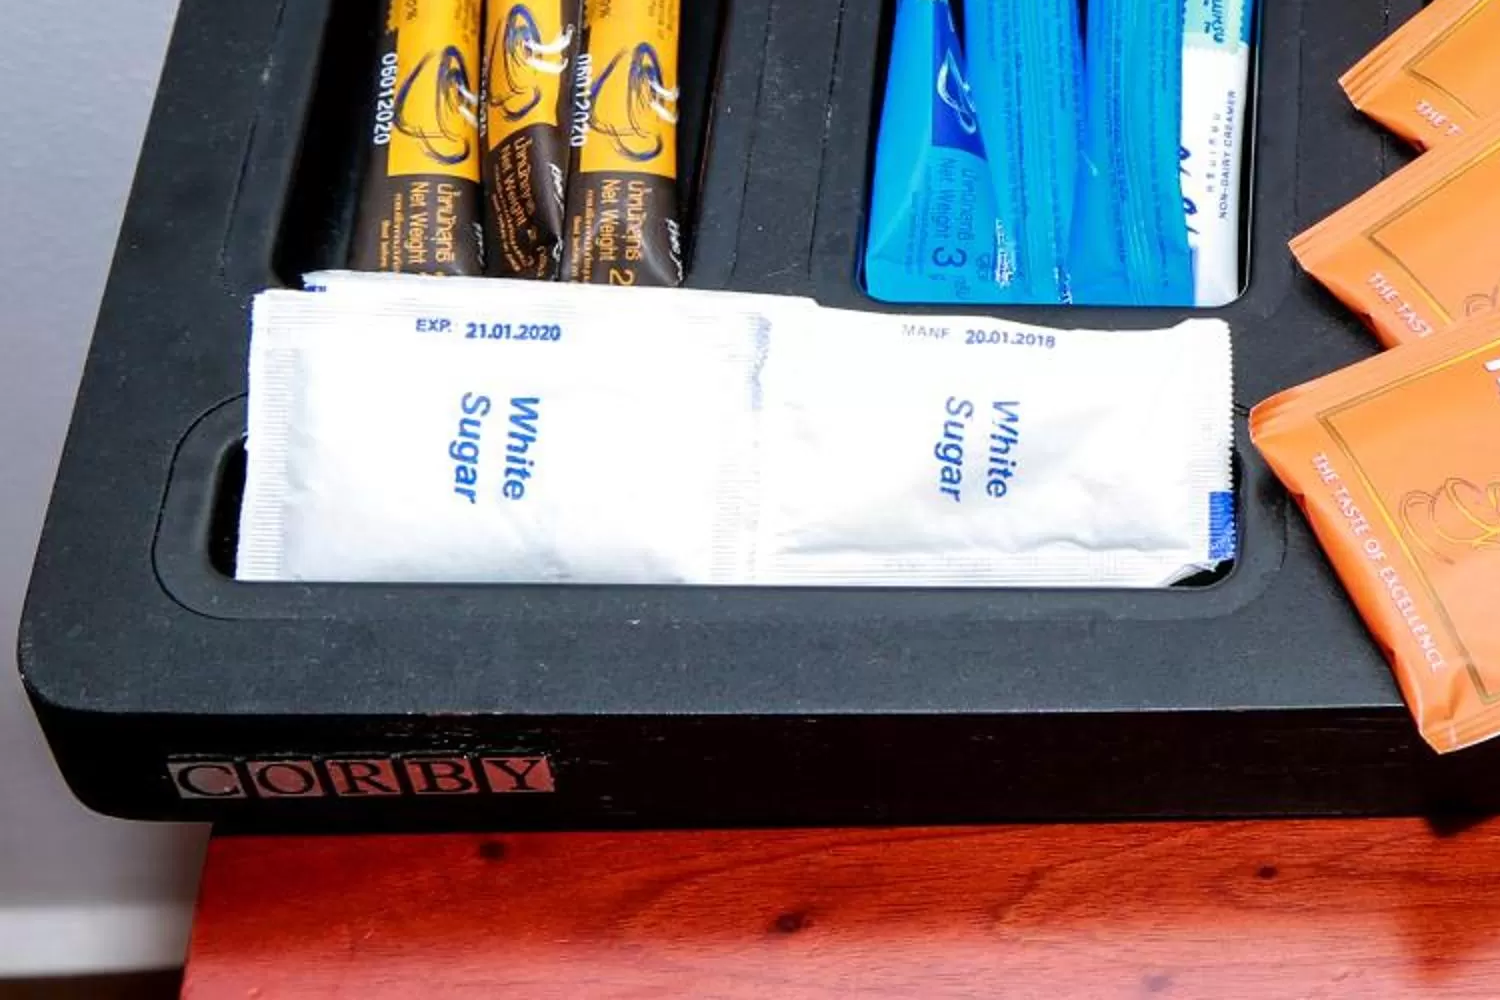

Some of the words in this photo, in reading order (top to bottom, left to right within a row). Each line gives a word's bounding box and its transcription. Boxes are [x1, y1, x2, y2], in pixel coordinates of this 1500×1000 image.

[1226, 90, 1237, 148] CREAMER
[408, 181, 431, 208] Net
[601, 179, 623, 204] Net
[404, 212, 430, 265] Weight
[595, 208, 622, 262] Weight
[931, 246, 968, 269] 3
[1366, 270, 1398, 305] THE
[1397, 300, 1434, 339] TAST
[465, 321, 562, 343] 21.01.2020
[964, 328, 1056, 349] 20.01.2018
[448, 391, 492, 504] Sugar
[502, 396, 541, 501] White
[933, 395, 975, 503] Sugar
[986, 400, 1020, 500] White
[1312, 450, 1338, 486] THE
[1333, 481, 1367, 535] TASTE
[1363, 535, 1387, 569] OF
[1377, 564, 1448, 673] EXCELLENCE
[172, 758, 552, 798] CORBY
